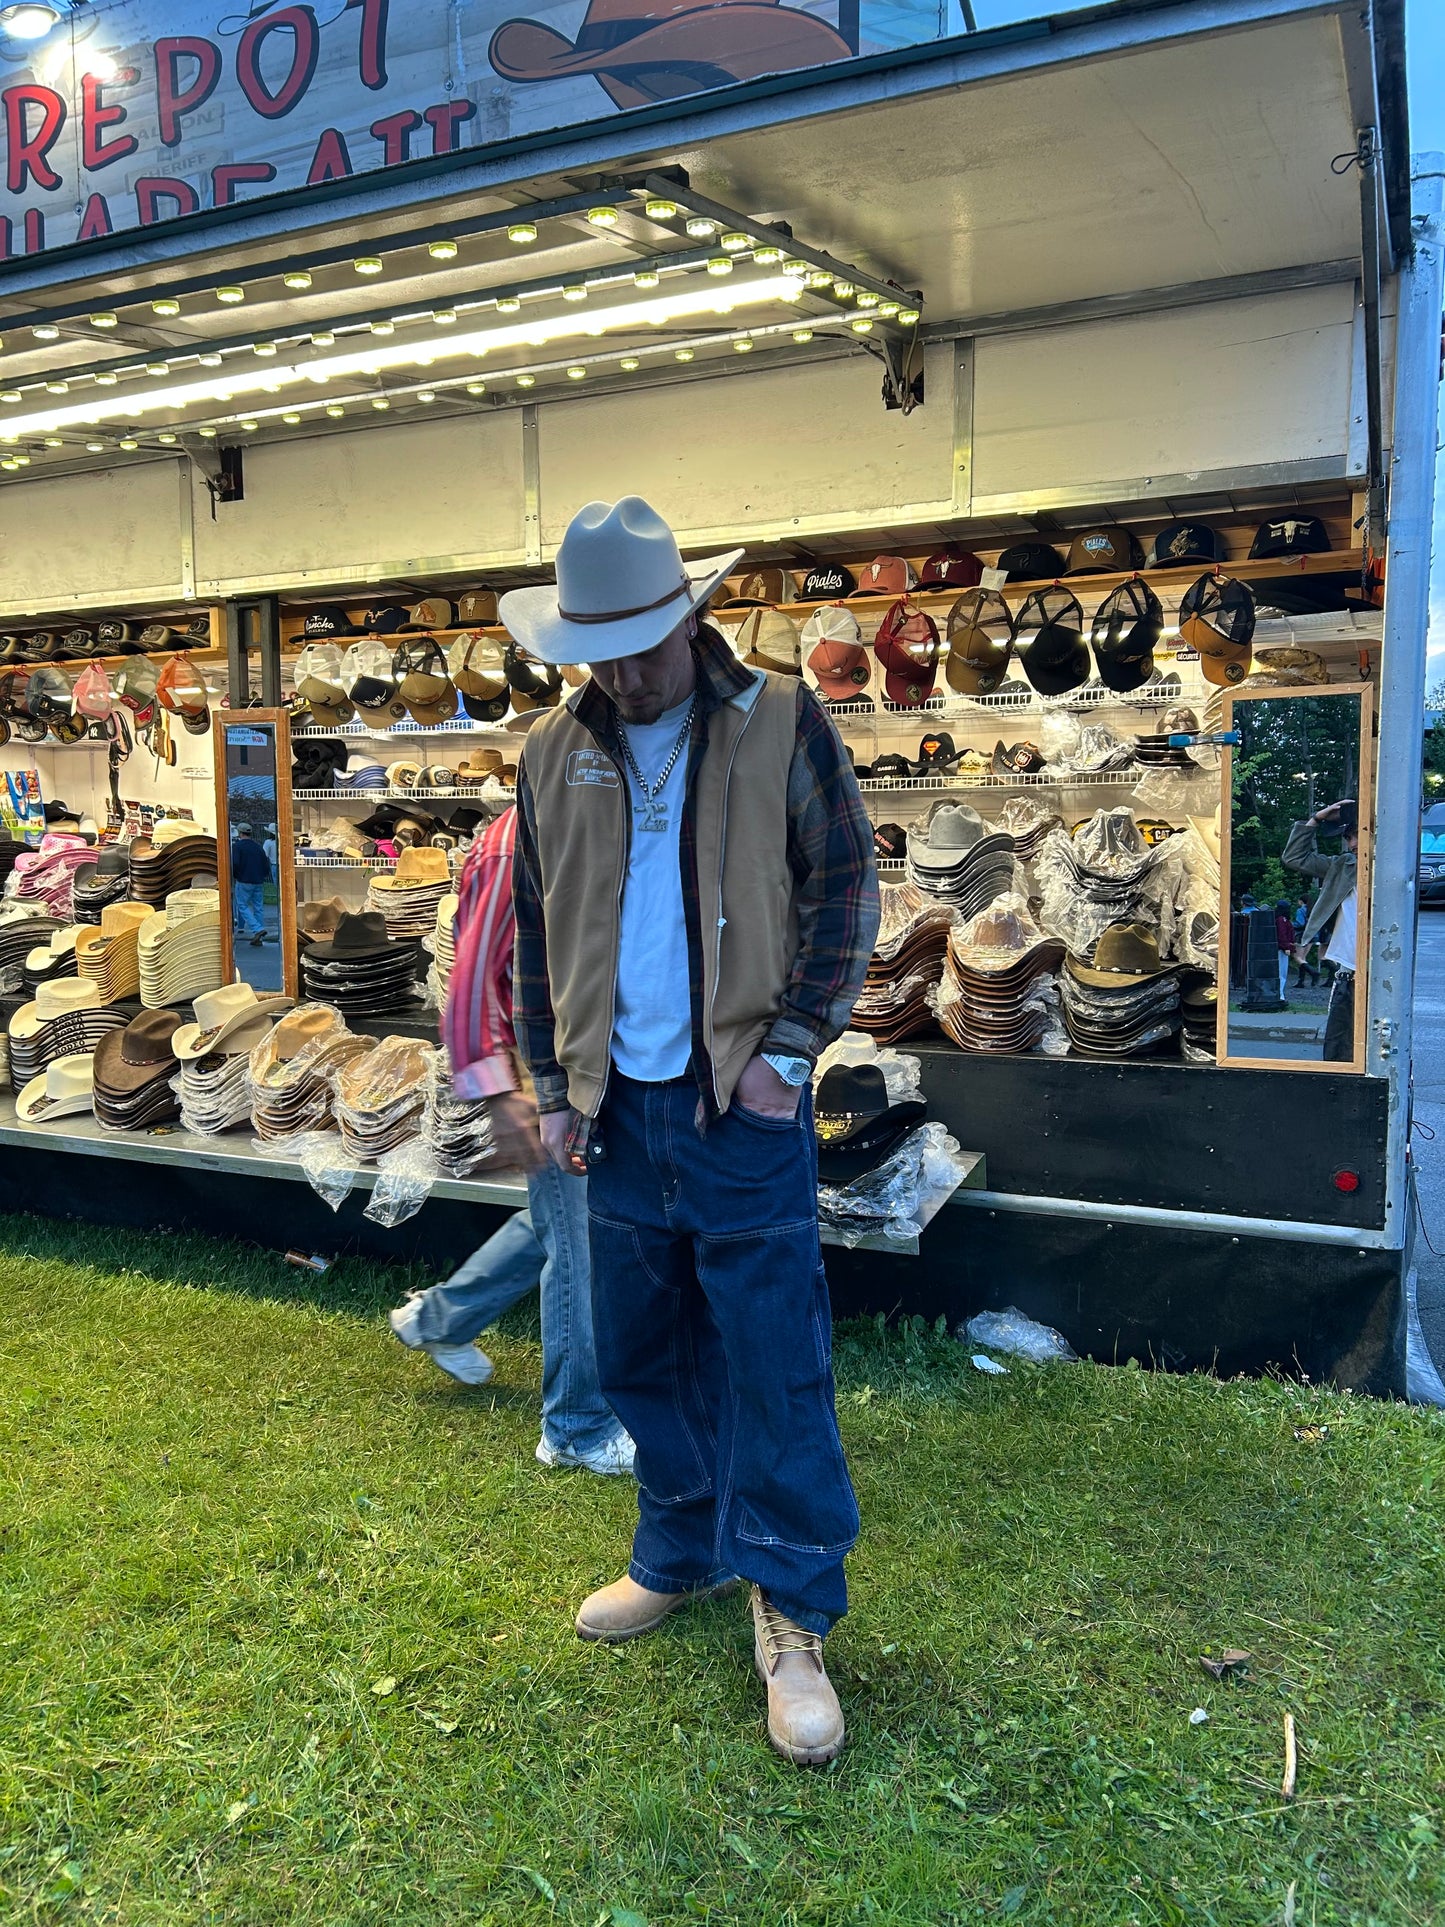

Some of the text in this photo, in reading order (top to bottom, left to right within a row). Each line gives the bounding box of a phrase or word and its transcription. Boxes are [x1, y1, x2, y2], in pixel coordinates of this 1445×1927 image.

[807, 570, 843, 592] Piales
[1155, 830, 1170, 841] CAT
[54, 1039, 85, 1056] RODEO
